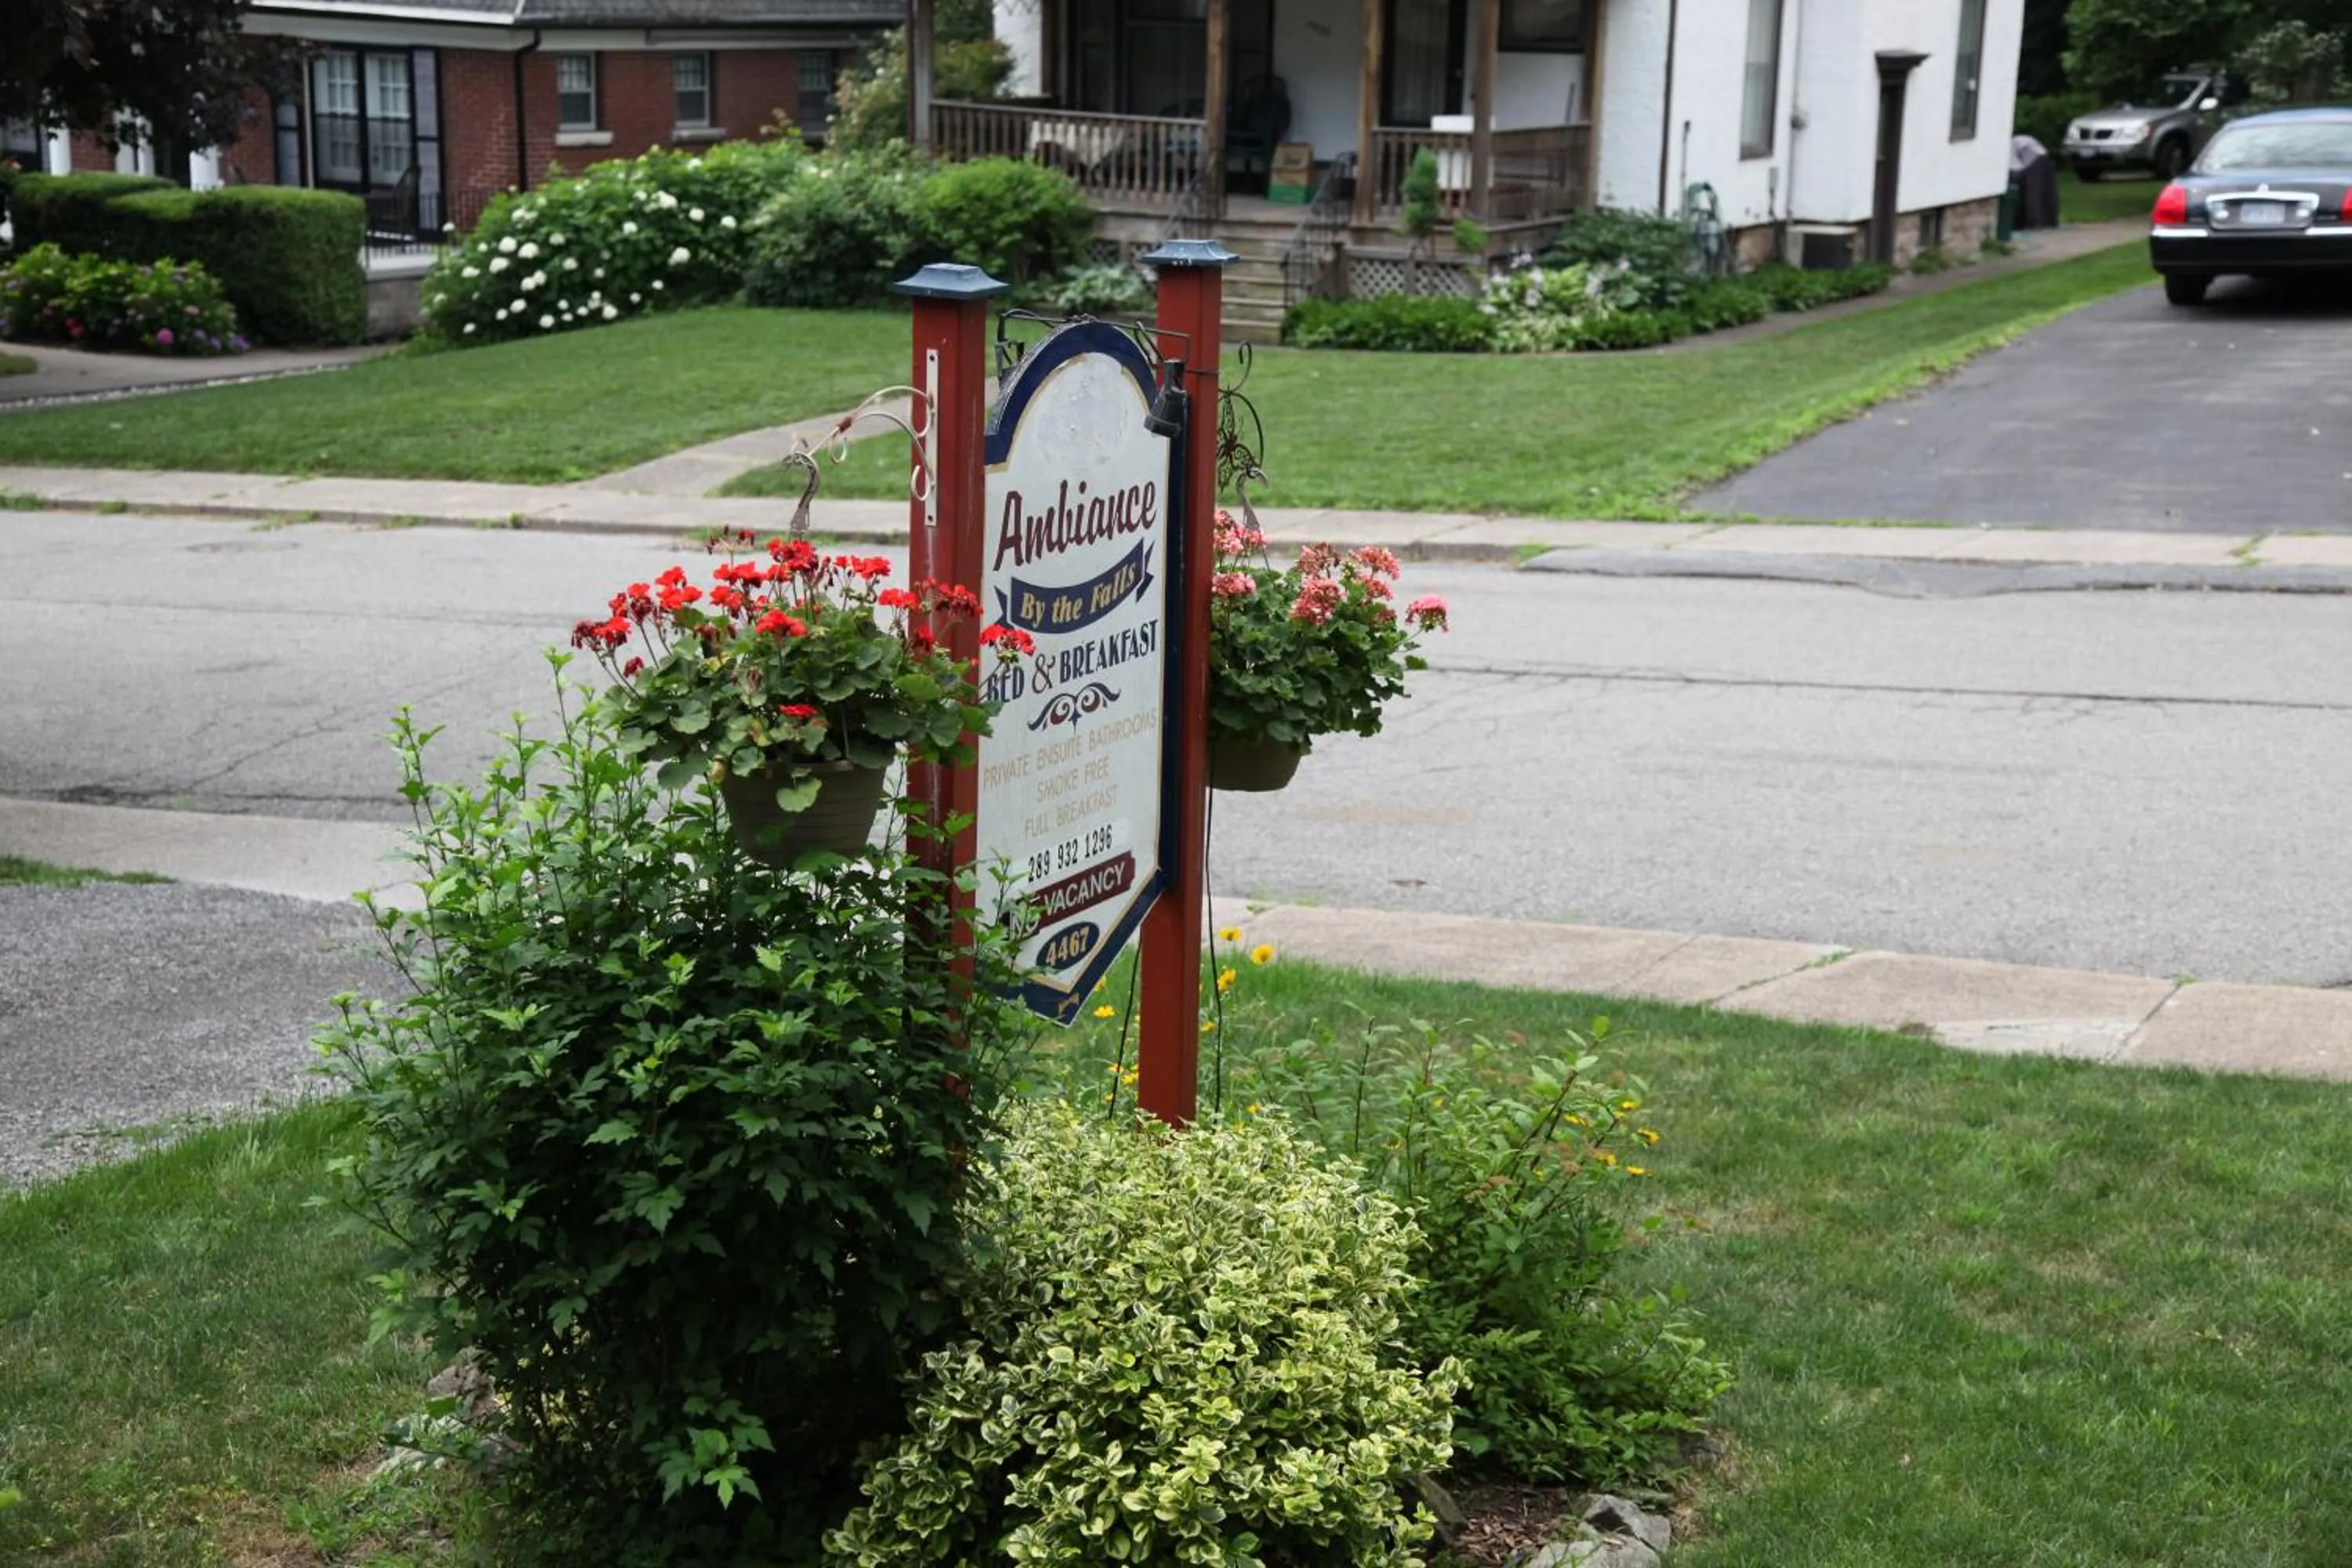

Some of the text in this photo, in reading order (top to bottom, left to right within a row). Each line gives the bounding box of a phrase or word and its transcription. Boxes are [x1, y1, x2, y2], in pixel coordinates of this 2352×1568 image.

[992, 479, 1156, 572] Ambiance
[1020, 561, 1137, 628] By the Falls
[987, 619, 1158, 703] BED & BREAKFAST
[982, 710, 1157, 790] PRIVATE ENSUITE BATHROOMS
[1036, 755, 1111, 804] SMOKE FREE
[1023, 784, 1119, 843] FULL BREAKFAST
[1028, 824, 1113, 884] 289 932 1296
[1044, 861, 1126, 917] VACANCY
[1044, 924, 1091, 967] 4467
